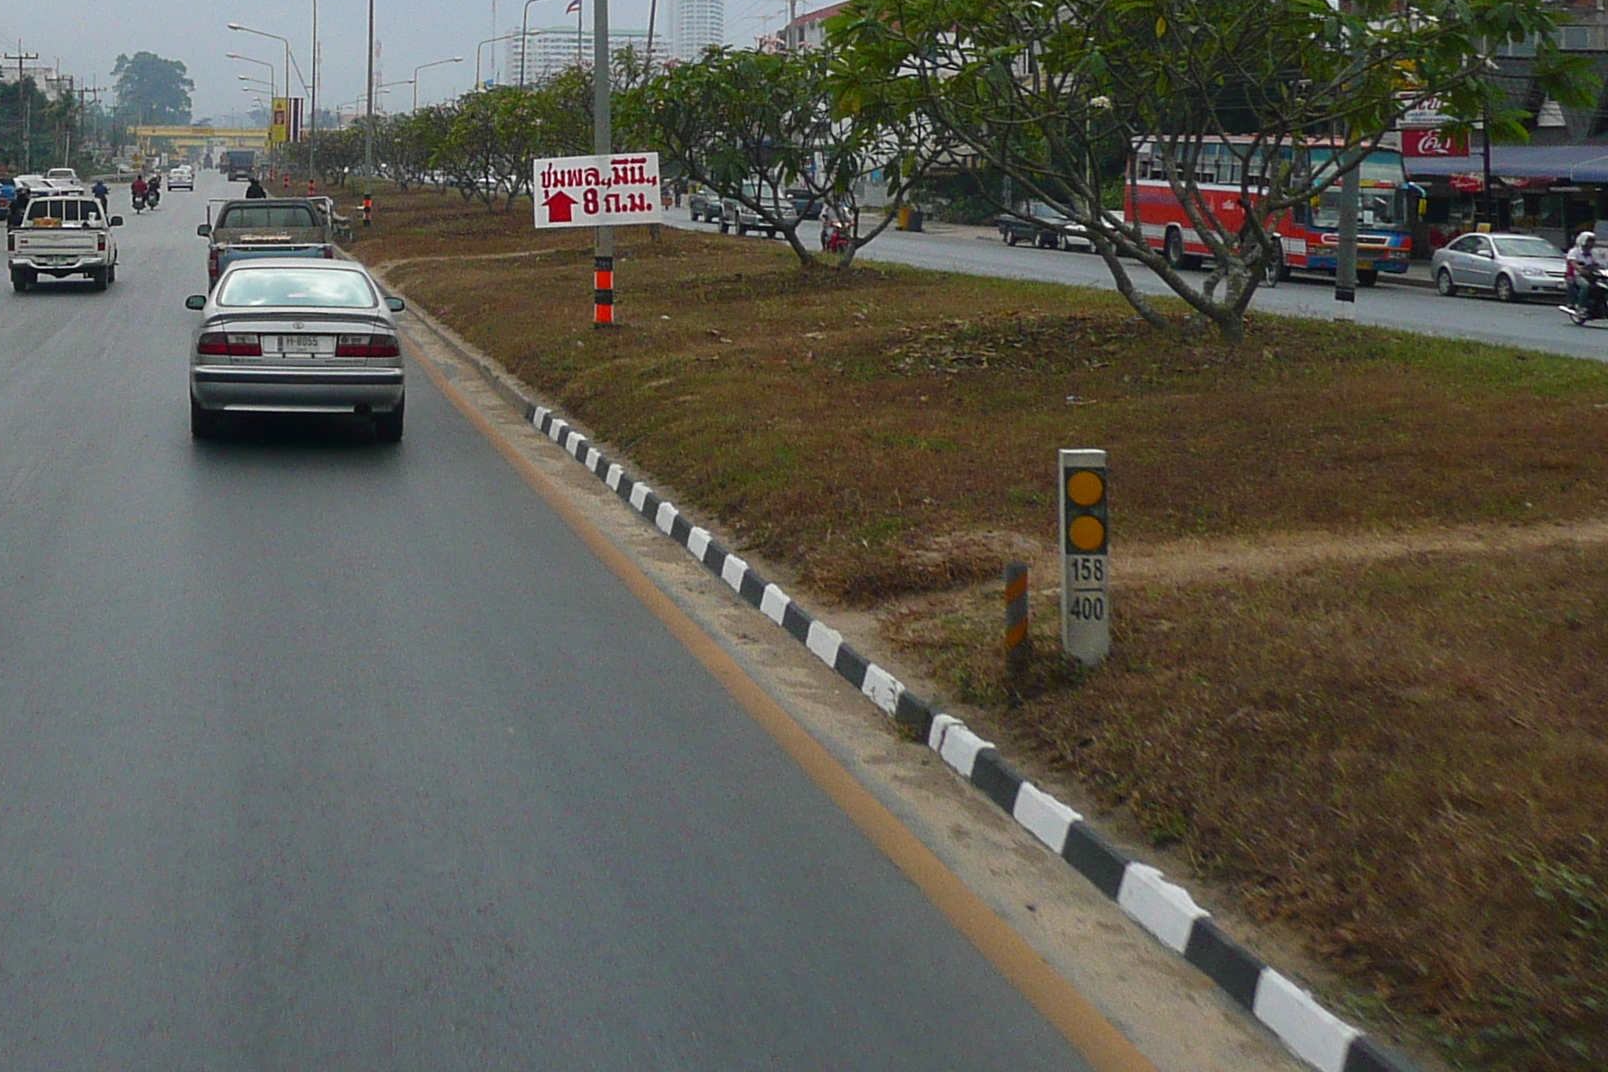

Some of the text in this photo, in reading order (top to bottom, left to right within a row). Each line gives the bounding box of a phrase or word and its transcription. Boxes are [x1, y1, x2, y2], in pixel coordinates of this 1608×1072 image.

[582, 187, 653, 215] 8 ก.ม.
[1070, 558, 1104, 582] 158
[1069, 597, 1104, 622] 400
